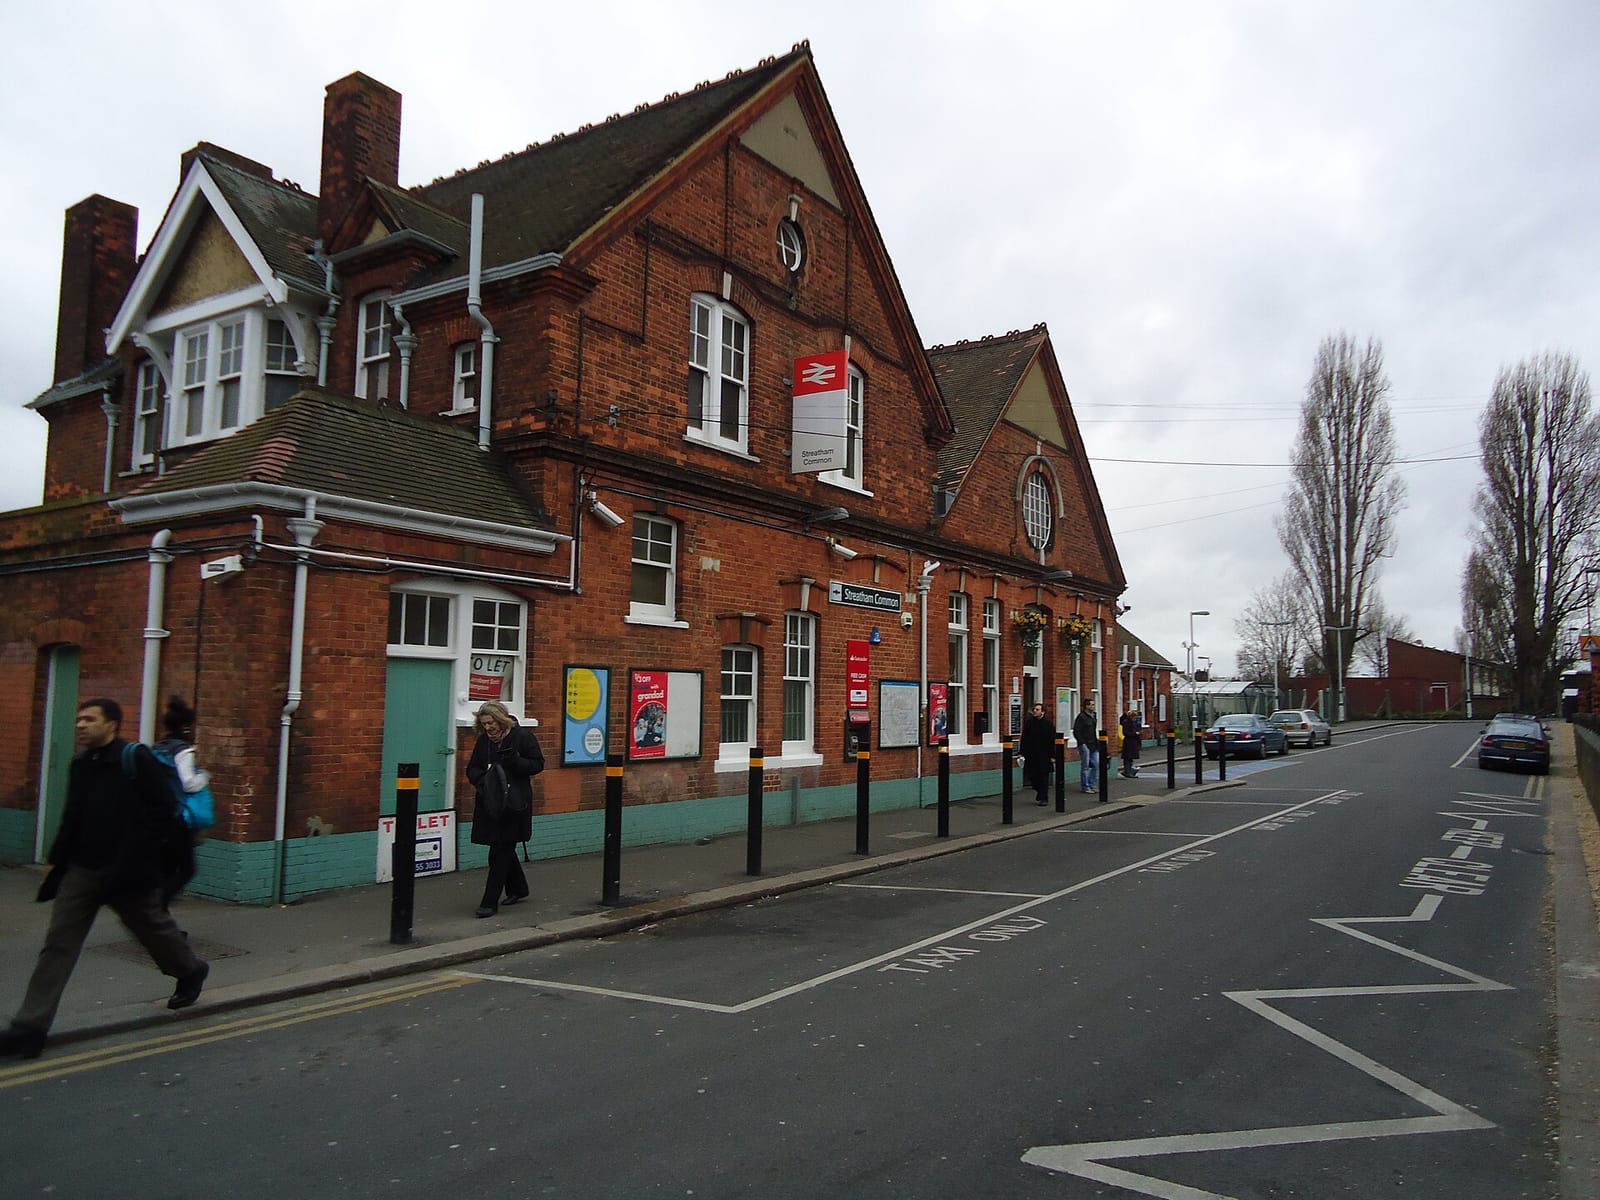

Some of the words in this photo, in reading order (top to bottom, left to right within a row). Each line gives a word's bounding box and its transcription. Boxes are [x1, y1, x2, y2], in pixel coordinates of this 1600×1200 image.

[801, 447, 834, 458] Streatham
[803, 457, 832, 466] Common
[844, 588, 874, 604] Streatham
[874, 593, 899, 608] Common
[473, 657, 483, 671] O
[487, 658, 511, 673] LET
[383, 820, 394, 833] T
[417, 814, 450, 830] LET
[1441, 827, 1504, 849] KEEP
[1398, 857, 1494, 896] CLEAR
[877, 946, 980, 973] TAXI
[968, 915, 1048, 941] ONLY
